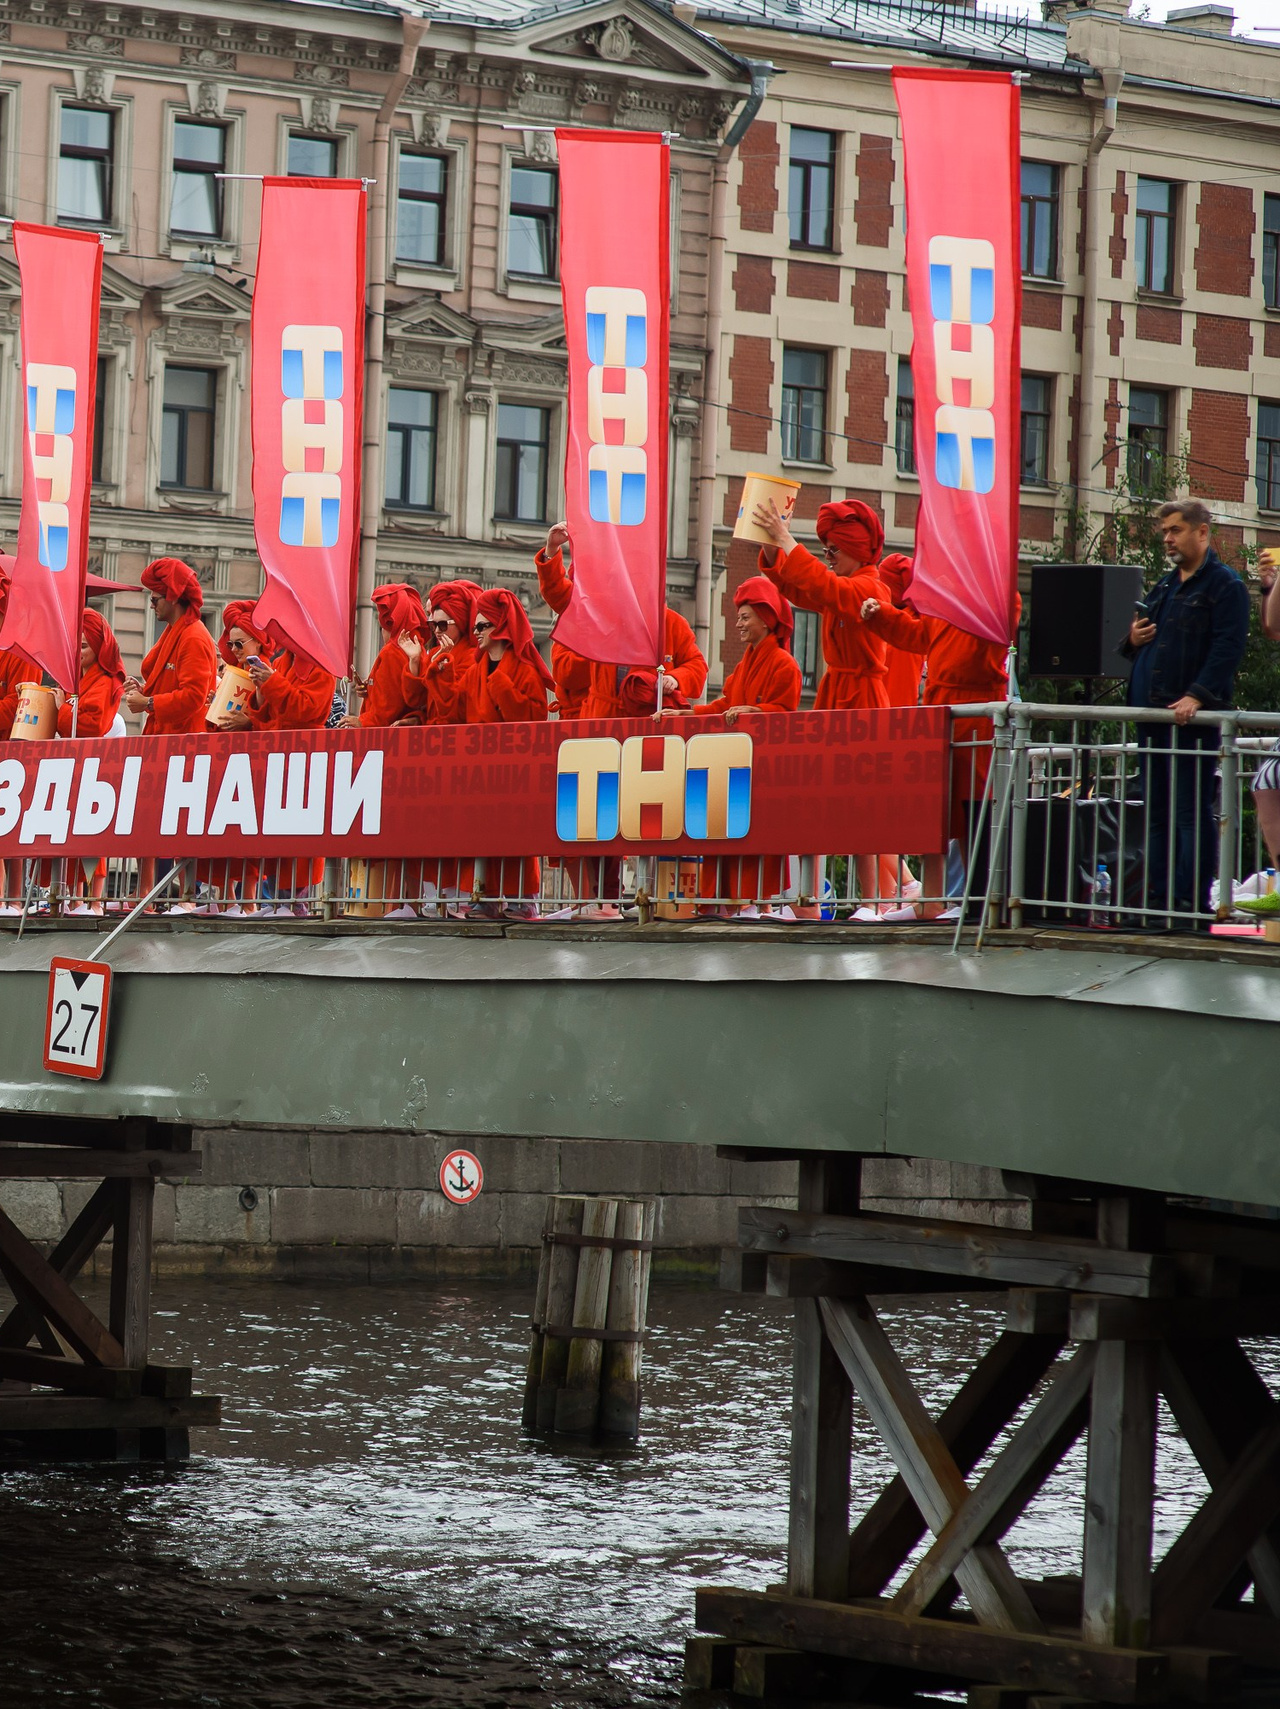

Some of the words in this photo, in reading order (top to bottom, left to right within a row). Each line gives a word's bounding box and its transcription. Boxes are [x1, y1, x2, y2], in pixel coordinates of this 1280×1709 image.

[279, 324, 344, 548] ТНТ
[585, 286, 648, 526] ТНТ
[928, 235, 996, 495] ТНТ
[159, 749, 385, 836] НАШИ
[555, 731, 754, 842] ТНТ
[51, 999, 100, 1056] 2.7
